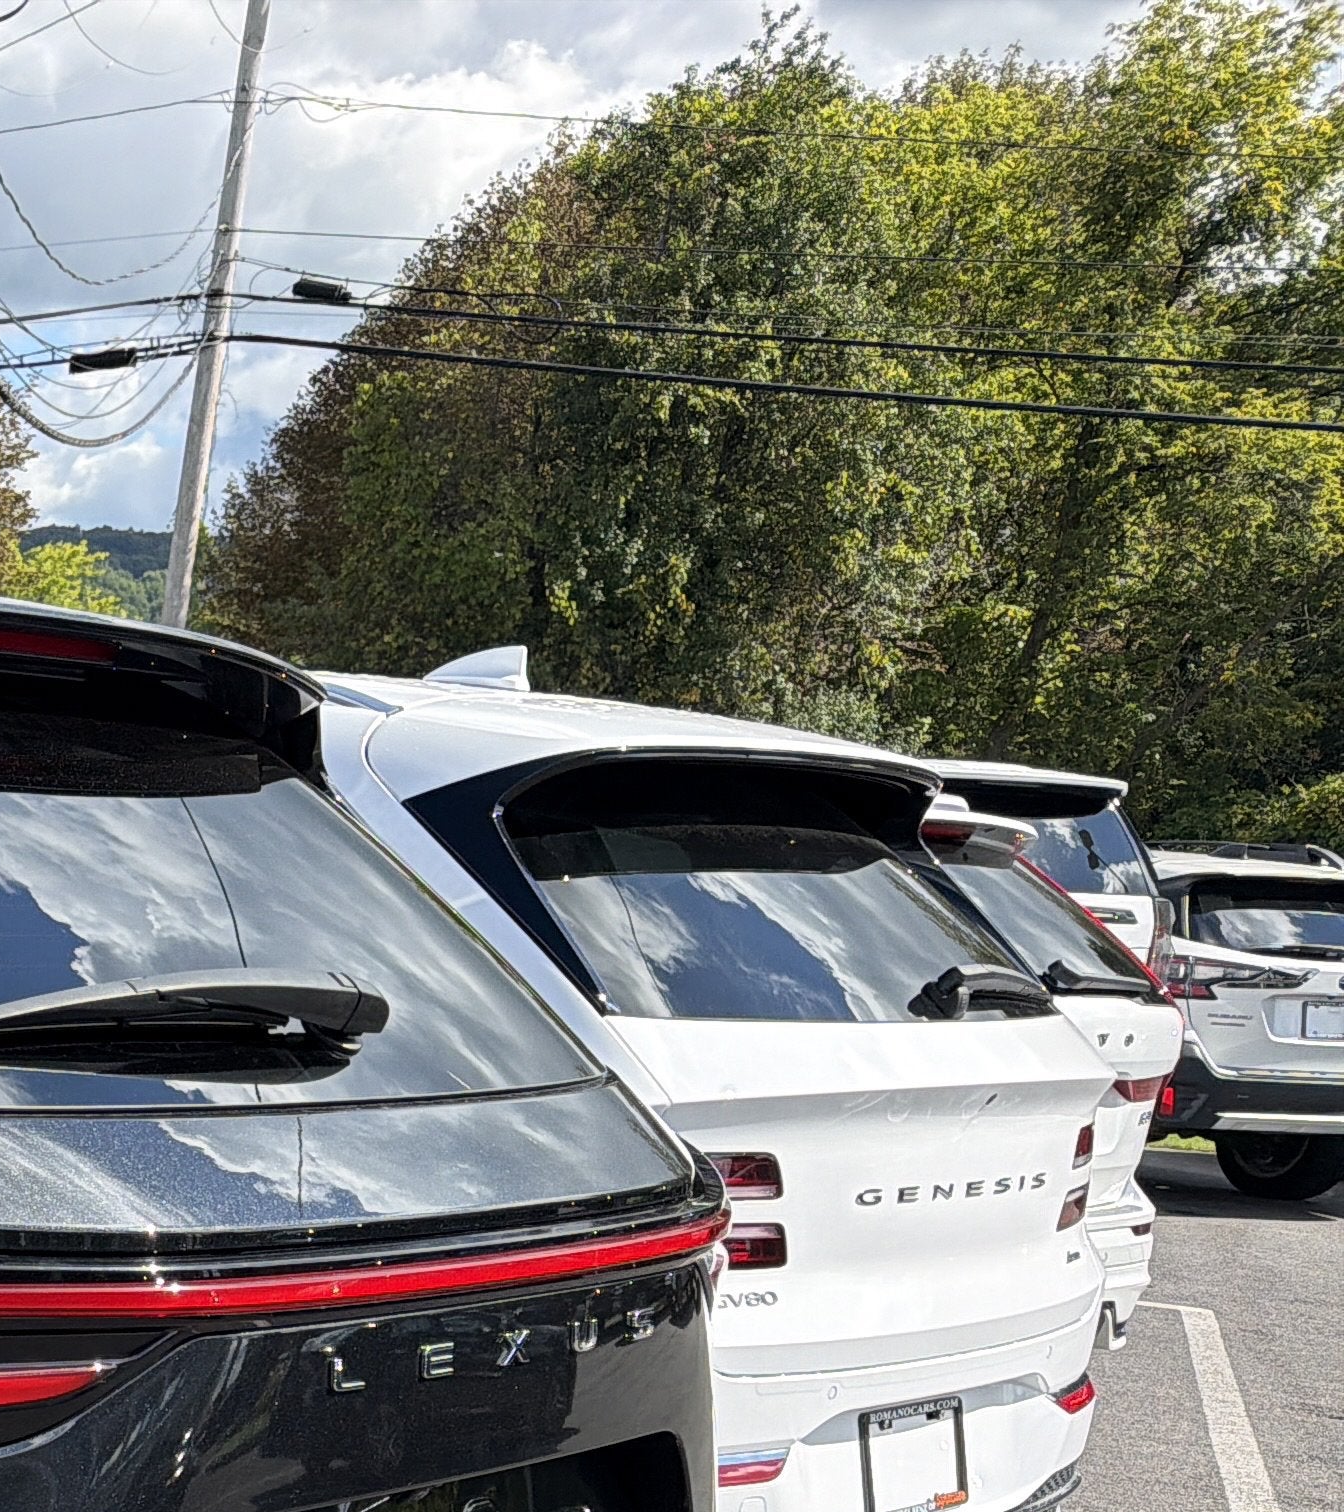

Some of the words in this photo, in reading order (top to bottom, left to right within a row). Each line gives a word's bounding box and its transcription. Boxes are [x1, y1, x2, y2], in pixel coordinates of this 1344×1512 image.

[854, 1172, 1047, 1207] GENESIS
[329, 1307, 656, 1393] LEXUS
[869, 1398, 960, 1423] ROMANOCARS.COM
